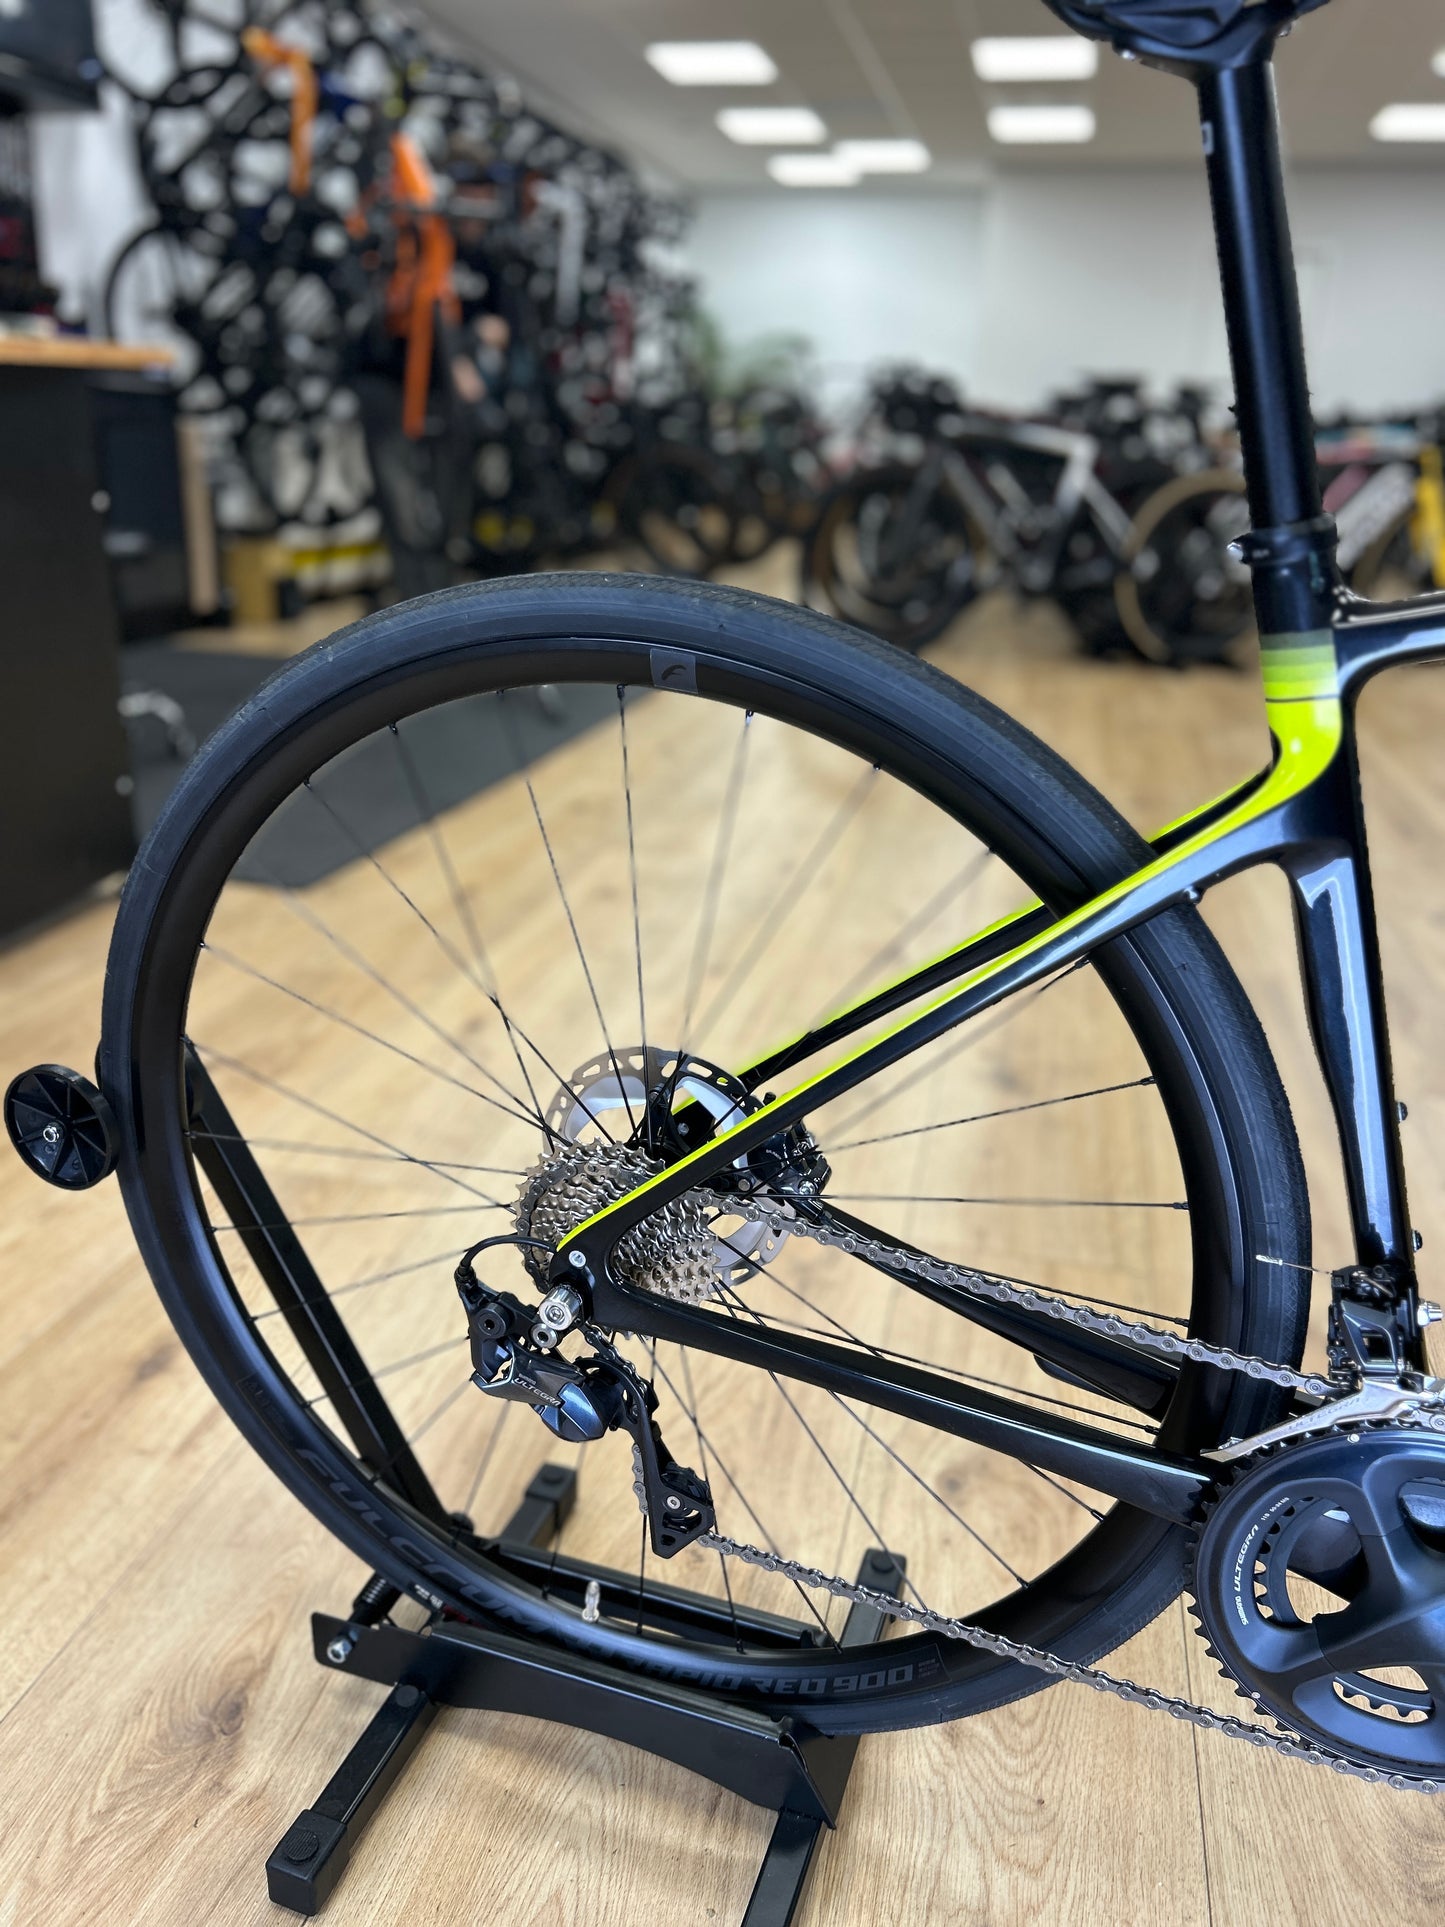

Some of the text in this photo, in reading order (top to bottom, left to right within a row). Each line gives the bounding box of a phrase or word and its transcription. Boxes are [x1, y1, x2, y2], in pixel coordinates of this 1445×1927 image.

[514, 1377, 562, 1406] ULTEGRA
[294, 1448, 558, 1638] FULCRUM
[1234, 1523, 1259, 1592] ULTEGRA
[1234, 1595, 1249, 1626] SHIMANO
[751, 1676, 828, 1695] RED
[833, 1663, 914, 1694] 900
